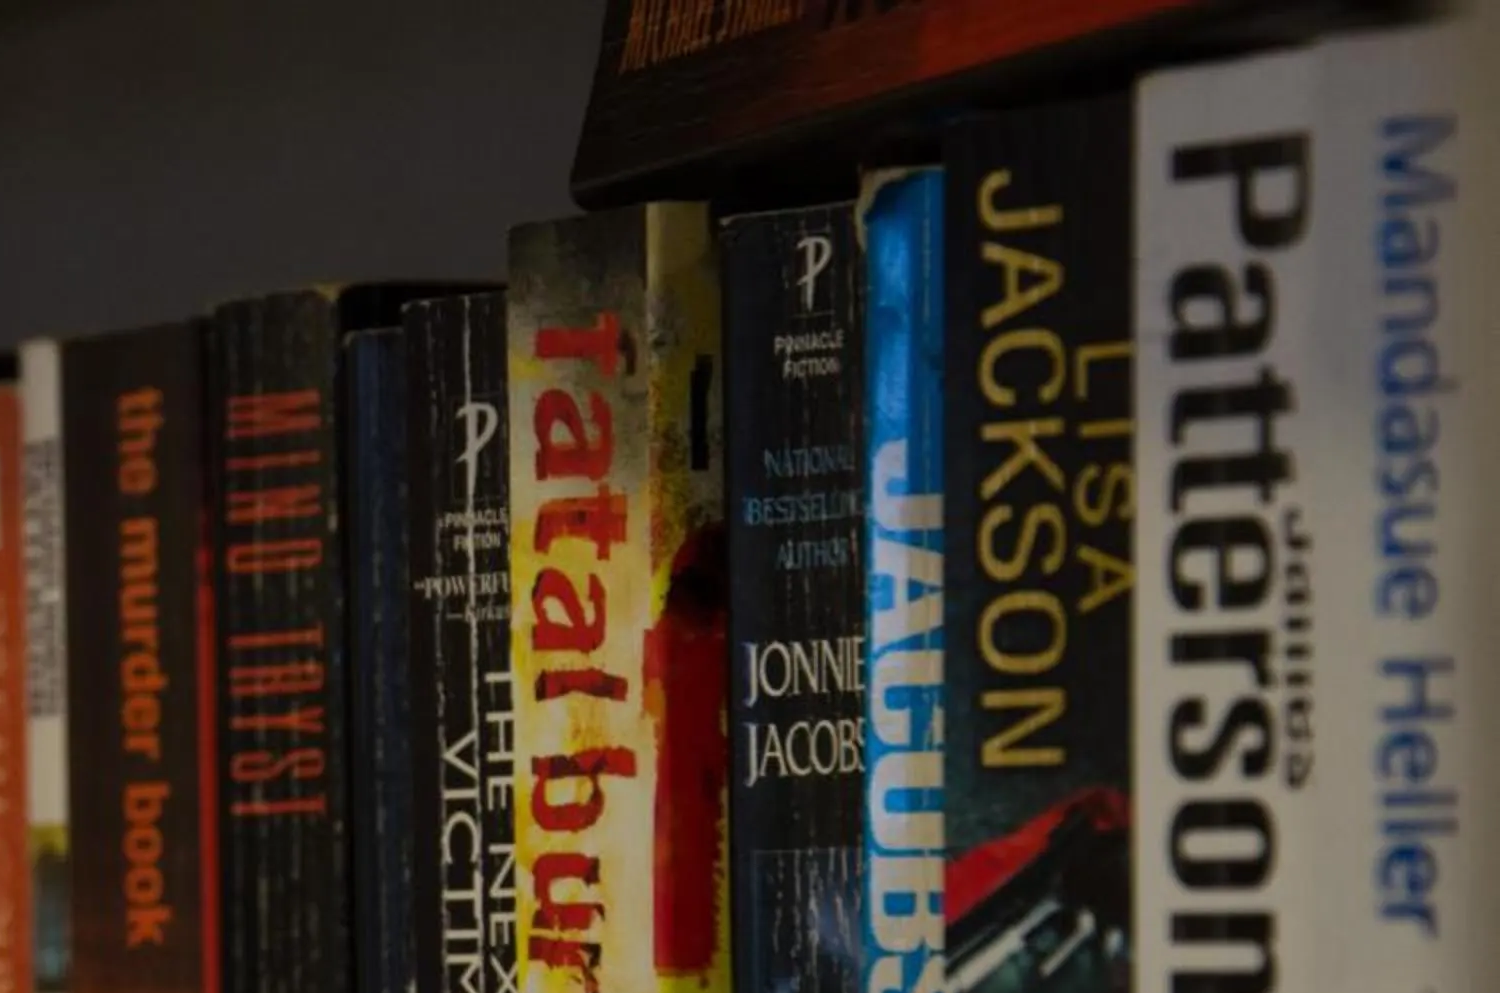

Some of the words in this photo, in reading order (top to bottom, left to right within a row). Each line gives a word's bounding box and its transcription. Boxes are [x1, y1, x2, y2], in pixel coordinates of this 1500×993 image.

[115, 383, 165, 497] the
[782, 357, 841, 381] FICTION
[1372, 110, 1459, 622] Mandasue
[224, 386, 323, 574] MIND
[741, 488, 864, 528] BESTSELLIN
[976, 166, 1067, 770] JACKSON
[1072, 338, 1135, 617] LISA
[117, 514, 169, 763] murder
[226, 621, 327, 819] TRYST
[741, 634, 866, 708] JONNIE
[484, 670, 515, 812] THE
[1372, 654, 1461, 942] Heller
[120, 779, 173, 949] book
